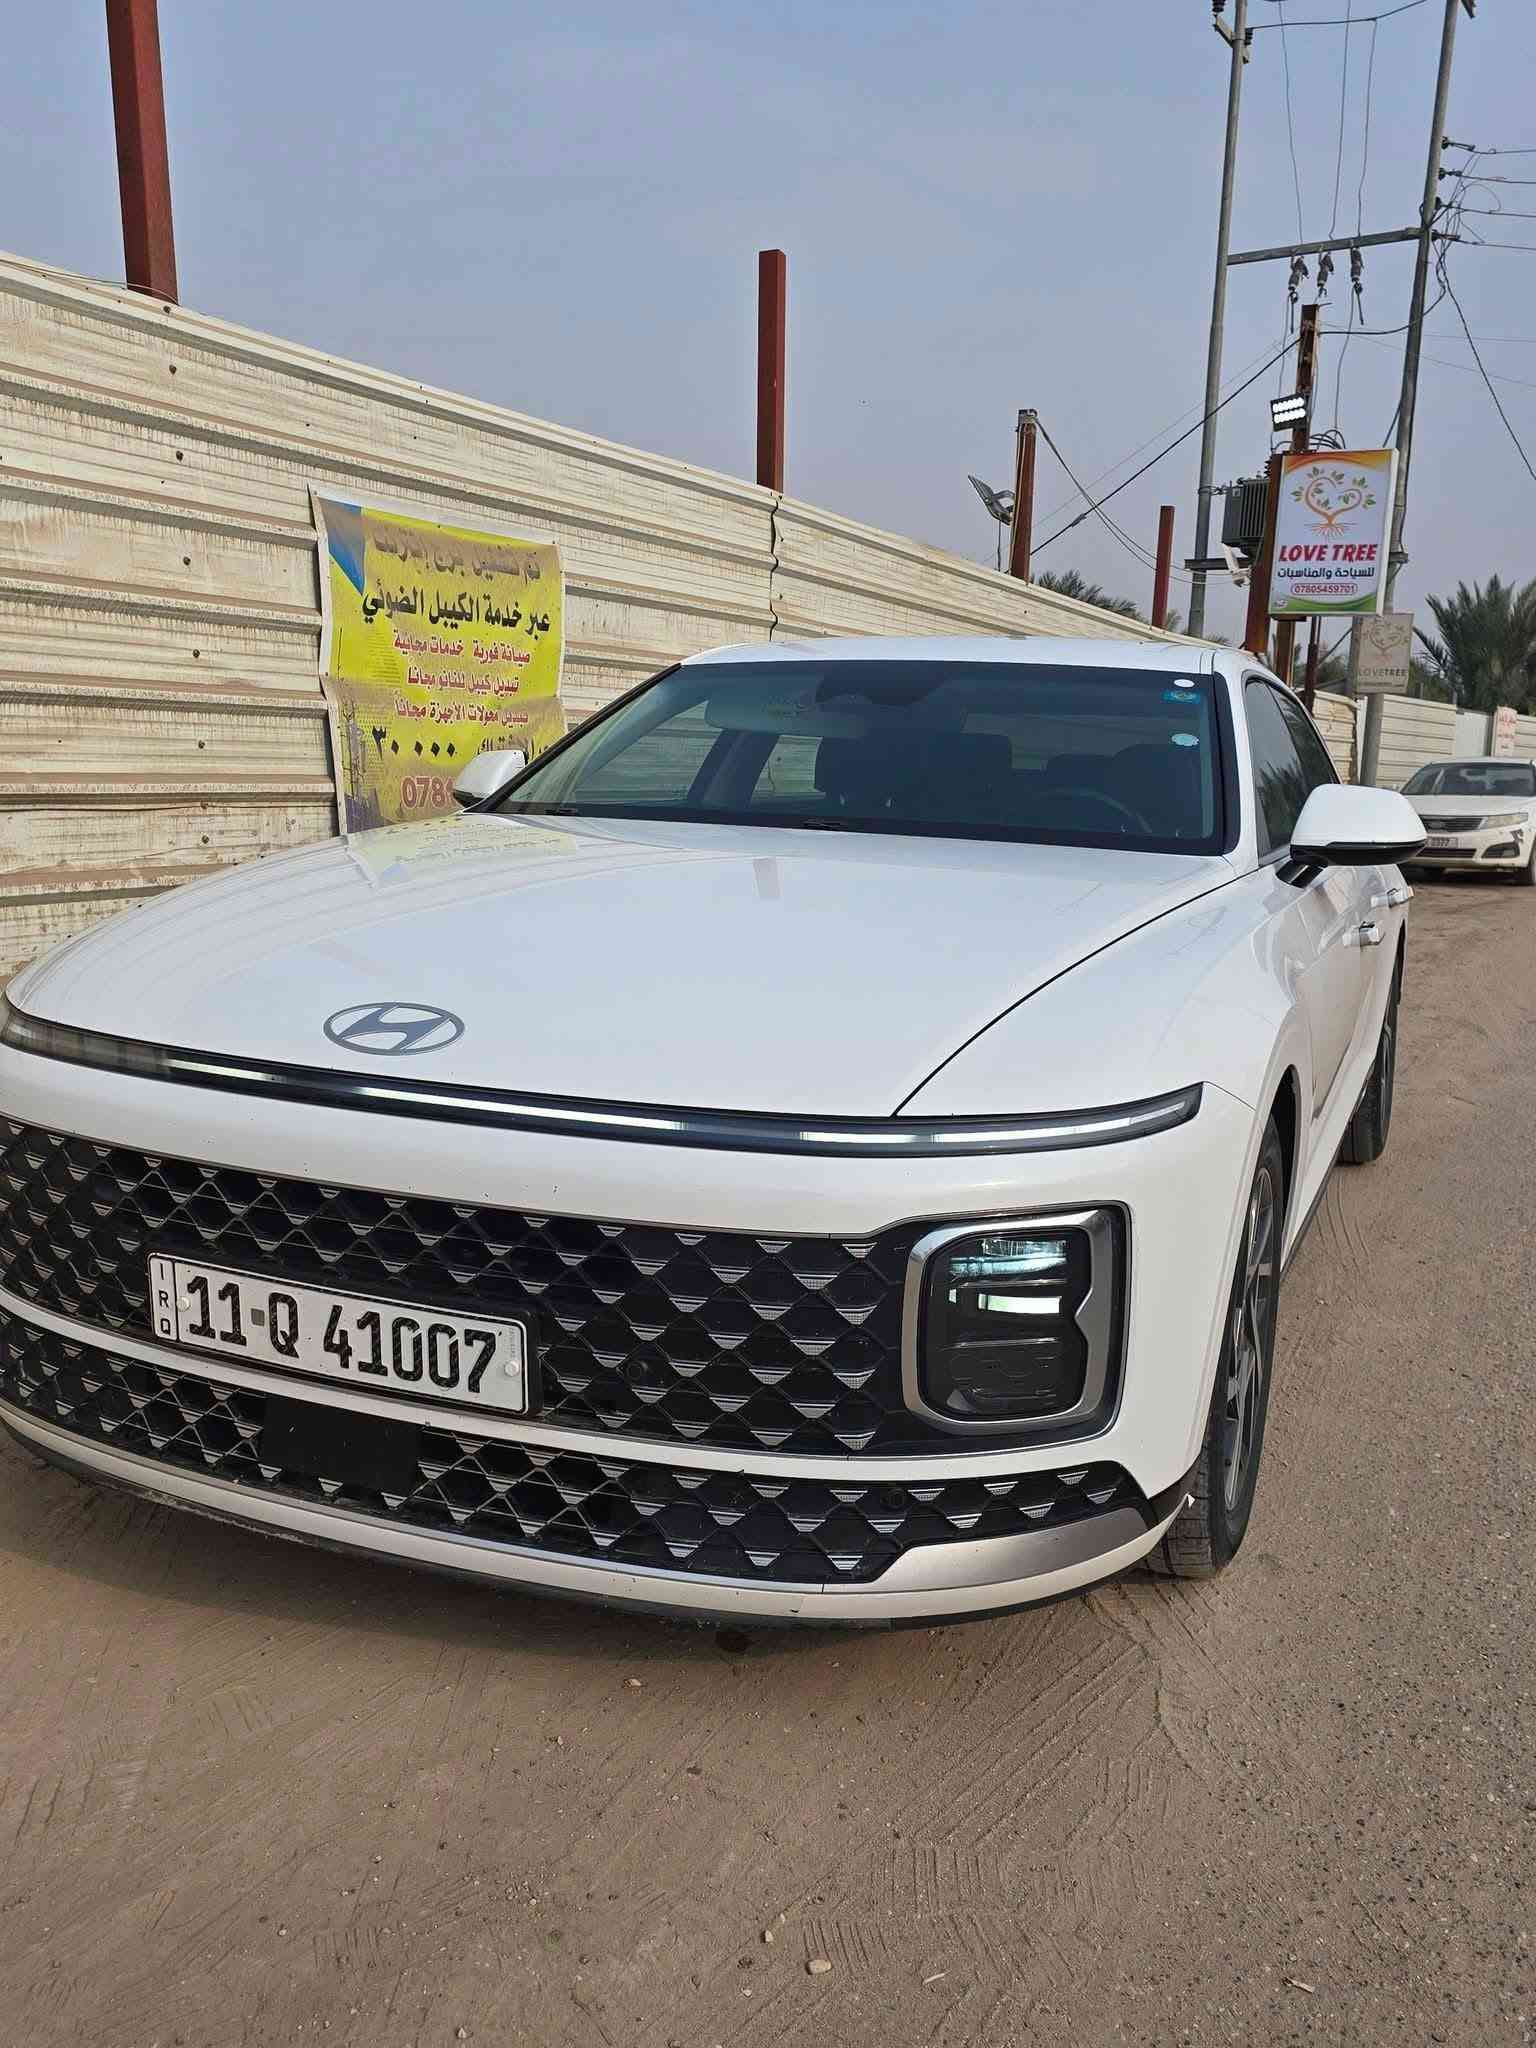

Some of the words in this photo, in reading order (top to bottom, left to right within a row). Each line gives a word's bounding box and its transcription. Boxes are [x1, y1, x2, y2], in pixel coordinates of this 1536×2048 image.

[1279, 544, 1328, 561] LOVE
[1332, 544, 1378, 562] TREE
[1278, 567, 1332, 580] والمناسبات
[1335, 567, 1375, 580] للسياحة
[362, 579, 424, 624] الضوئي
[429, 591, 480, 630] الكيبل
[484, 594, 523, 628] خدمة
[525, 611, 550, 640] عبر
[393, 629, 428, 656] مجانية
[430, 636, 464, 657] خدمات
[473, 640, 499, 664] فورية
[501, 642, 530, 667] صيانة
[158, 1262, 172, 1335] IRQ
[186, 1275, 247, 1347] 11
[267, 1291, 300, 1358] Q
[322, 1305, 497, 1393] 41007
